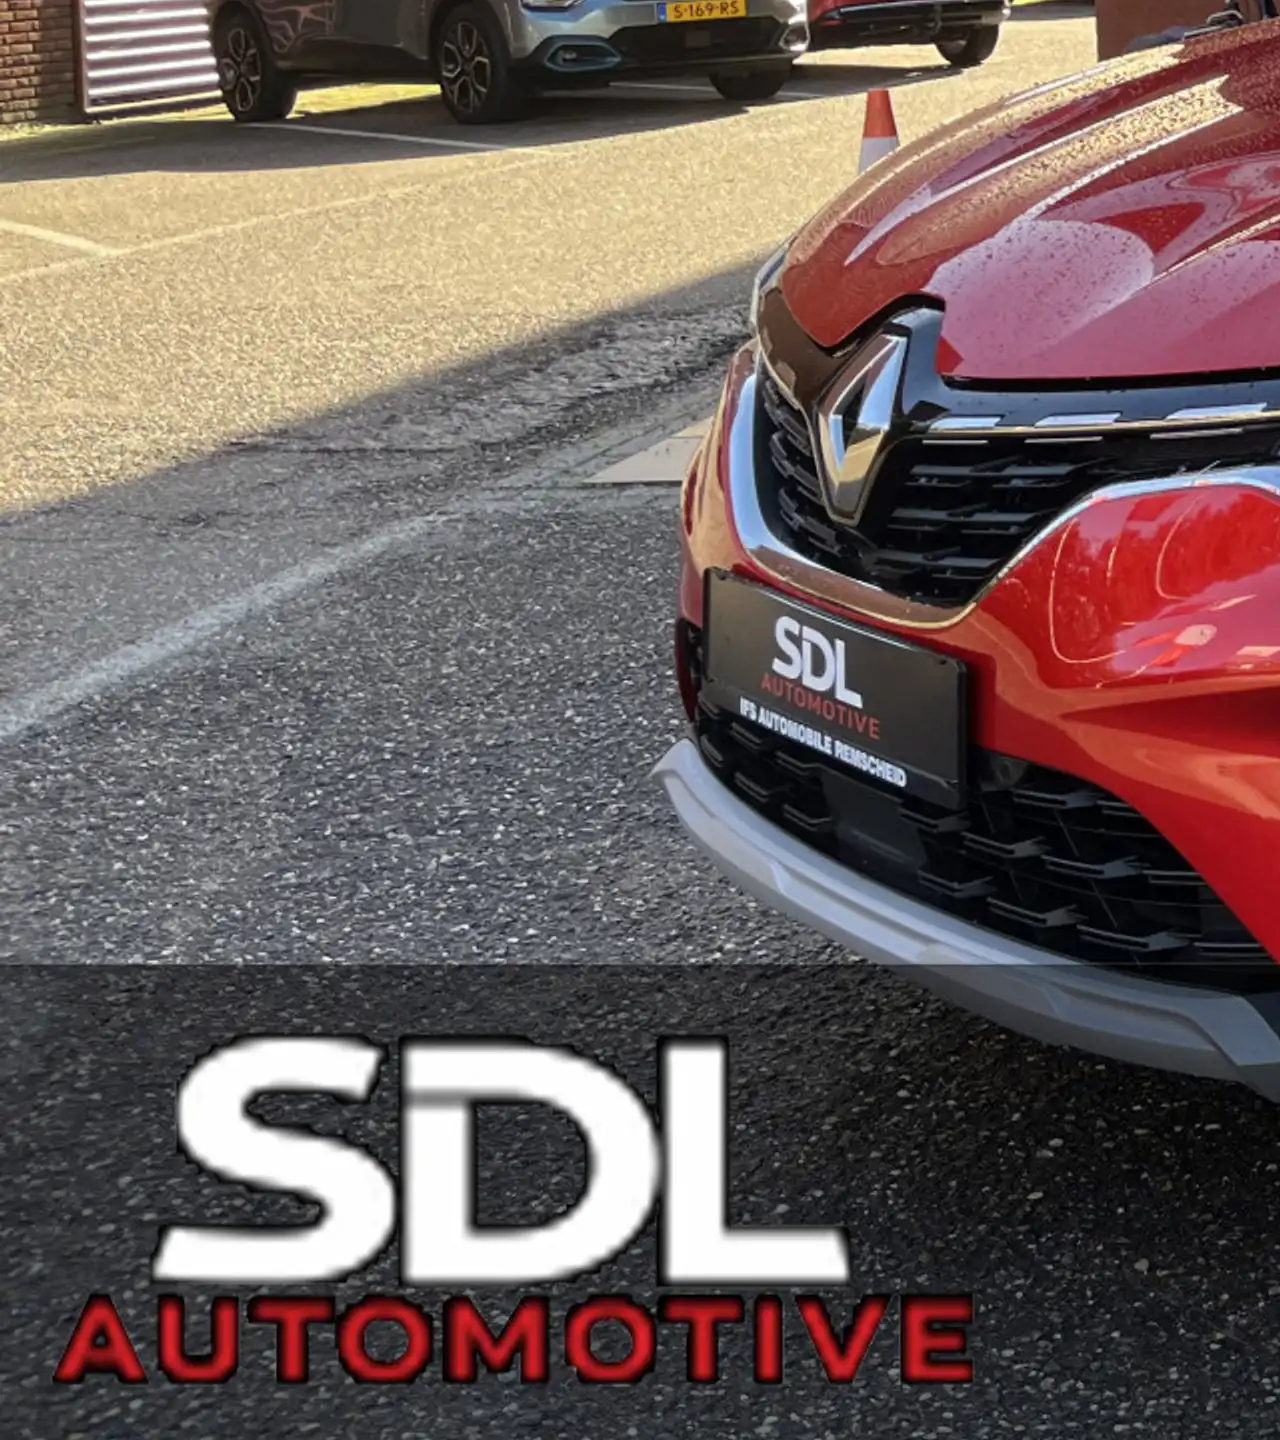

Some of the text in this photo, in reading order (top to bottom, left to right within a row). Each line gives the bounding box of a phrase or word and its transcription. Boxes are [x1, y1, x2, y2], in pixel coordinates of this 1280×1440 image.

[673, 0, 740, 19] S-169-RS
[771, 615, 863, 709] SDL
[761, 672, 880, 740] AUTOMOTIVE
[758, 705, 832, 755] AUTOMOBILE
[834, 739, 907, 788] REMSCHEID
